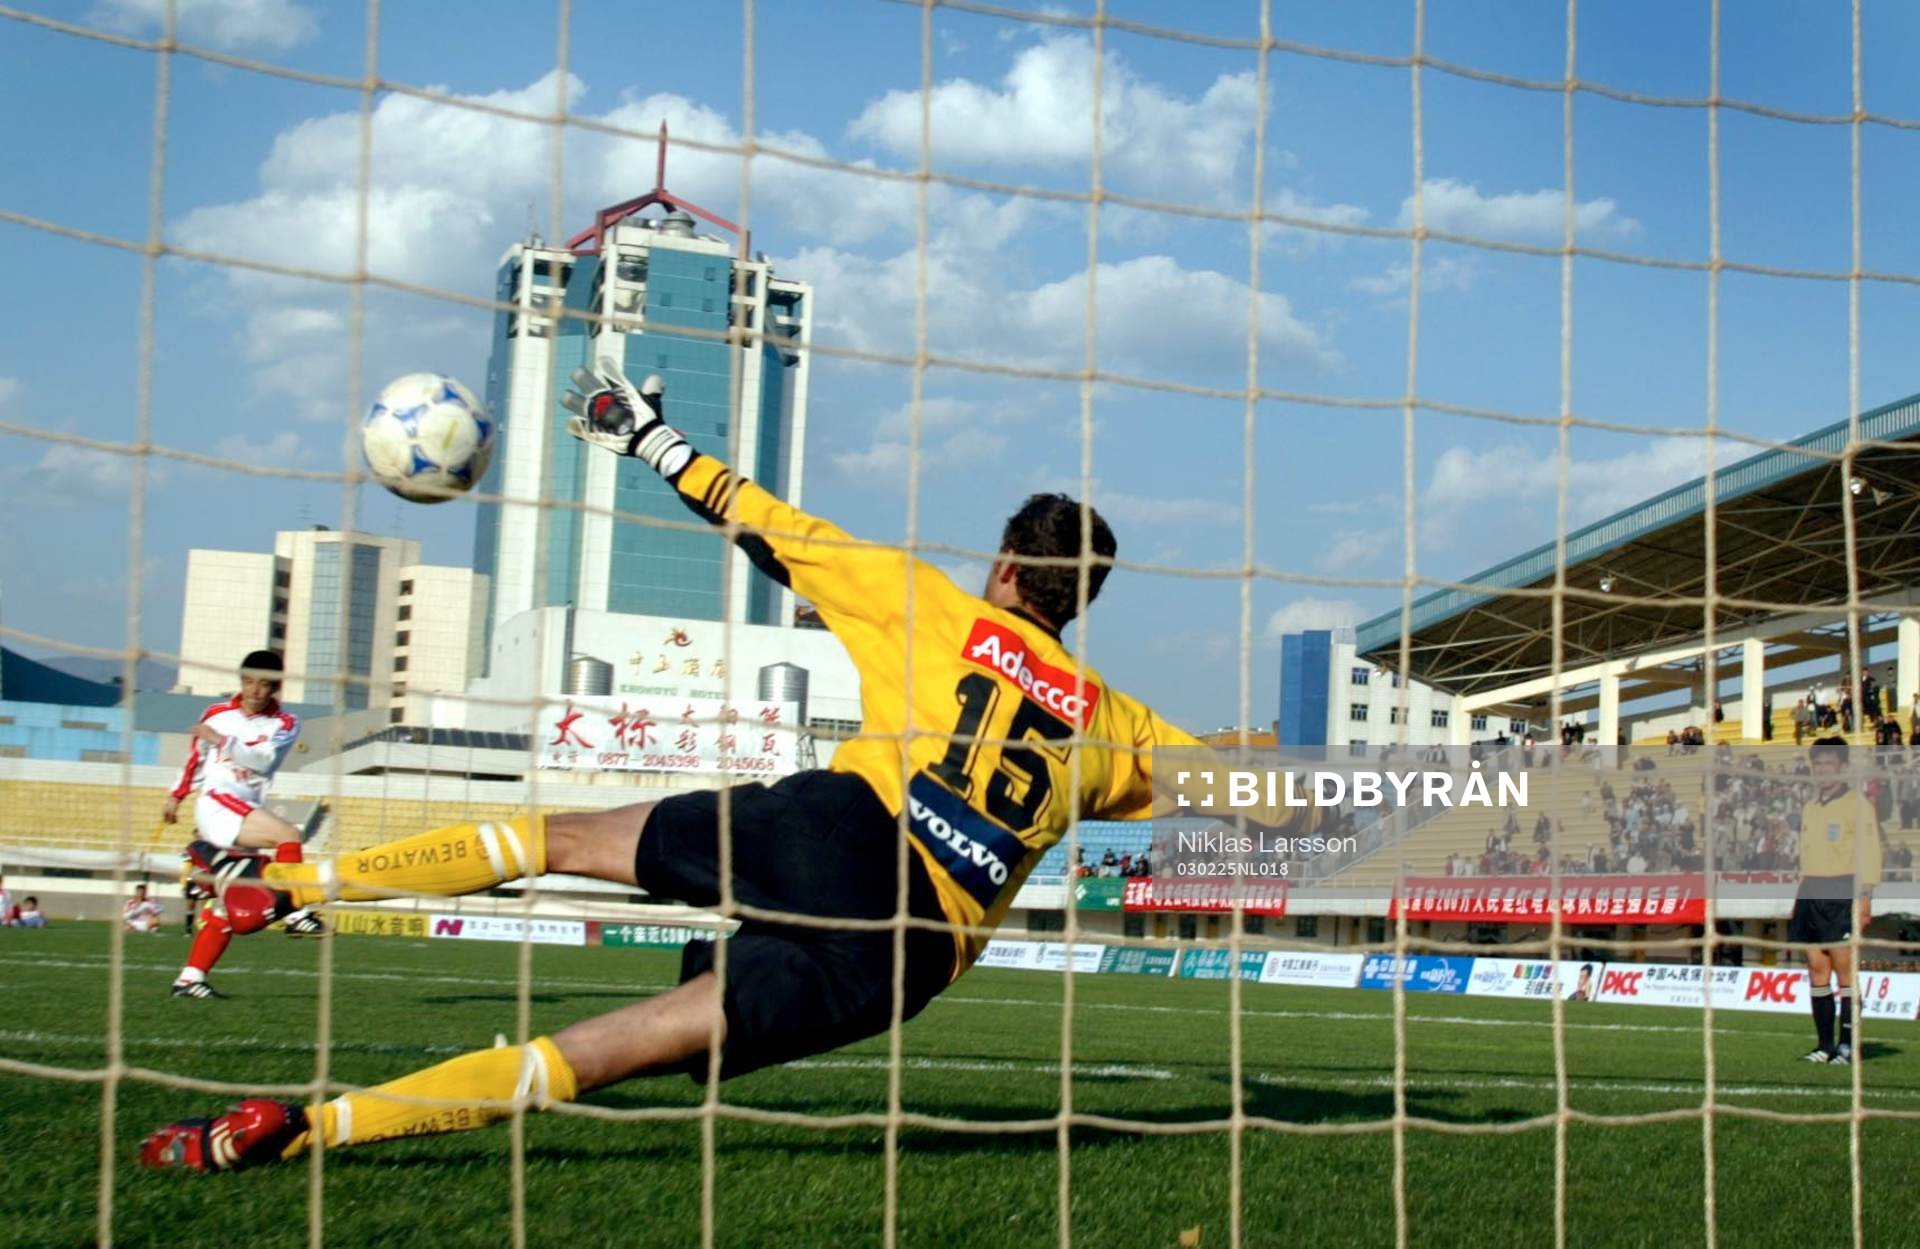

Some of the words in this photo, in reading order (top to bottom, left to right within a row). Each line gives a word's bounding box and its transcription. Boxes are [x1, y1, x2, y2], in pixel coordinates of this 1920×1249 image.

[972, 634, 1089, 719] Adecco
[926, 671, 1075, 836] 15
[358, 839, 467, 873] BEWATOR
[908, 796, 1009, 885] VOLVO
[1601, 970, 1644, 996] PICC
[1646, 966, 1740, 984] 中国人民保公司
[1744, 970, 1802, 1004] PICC
